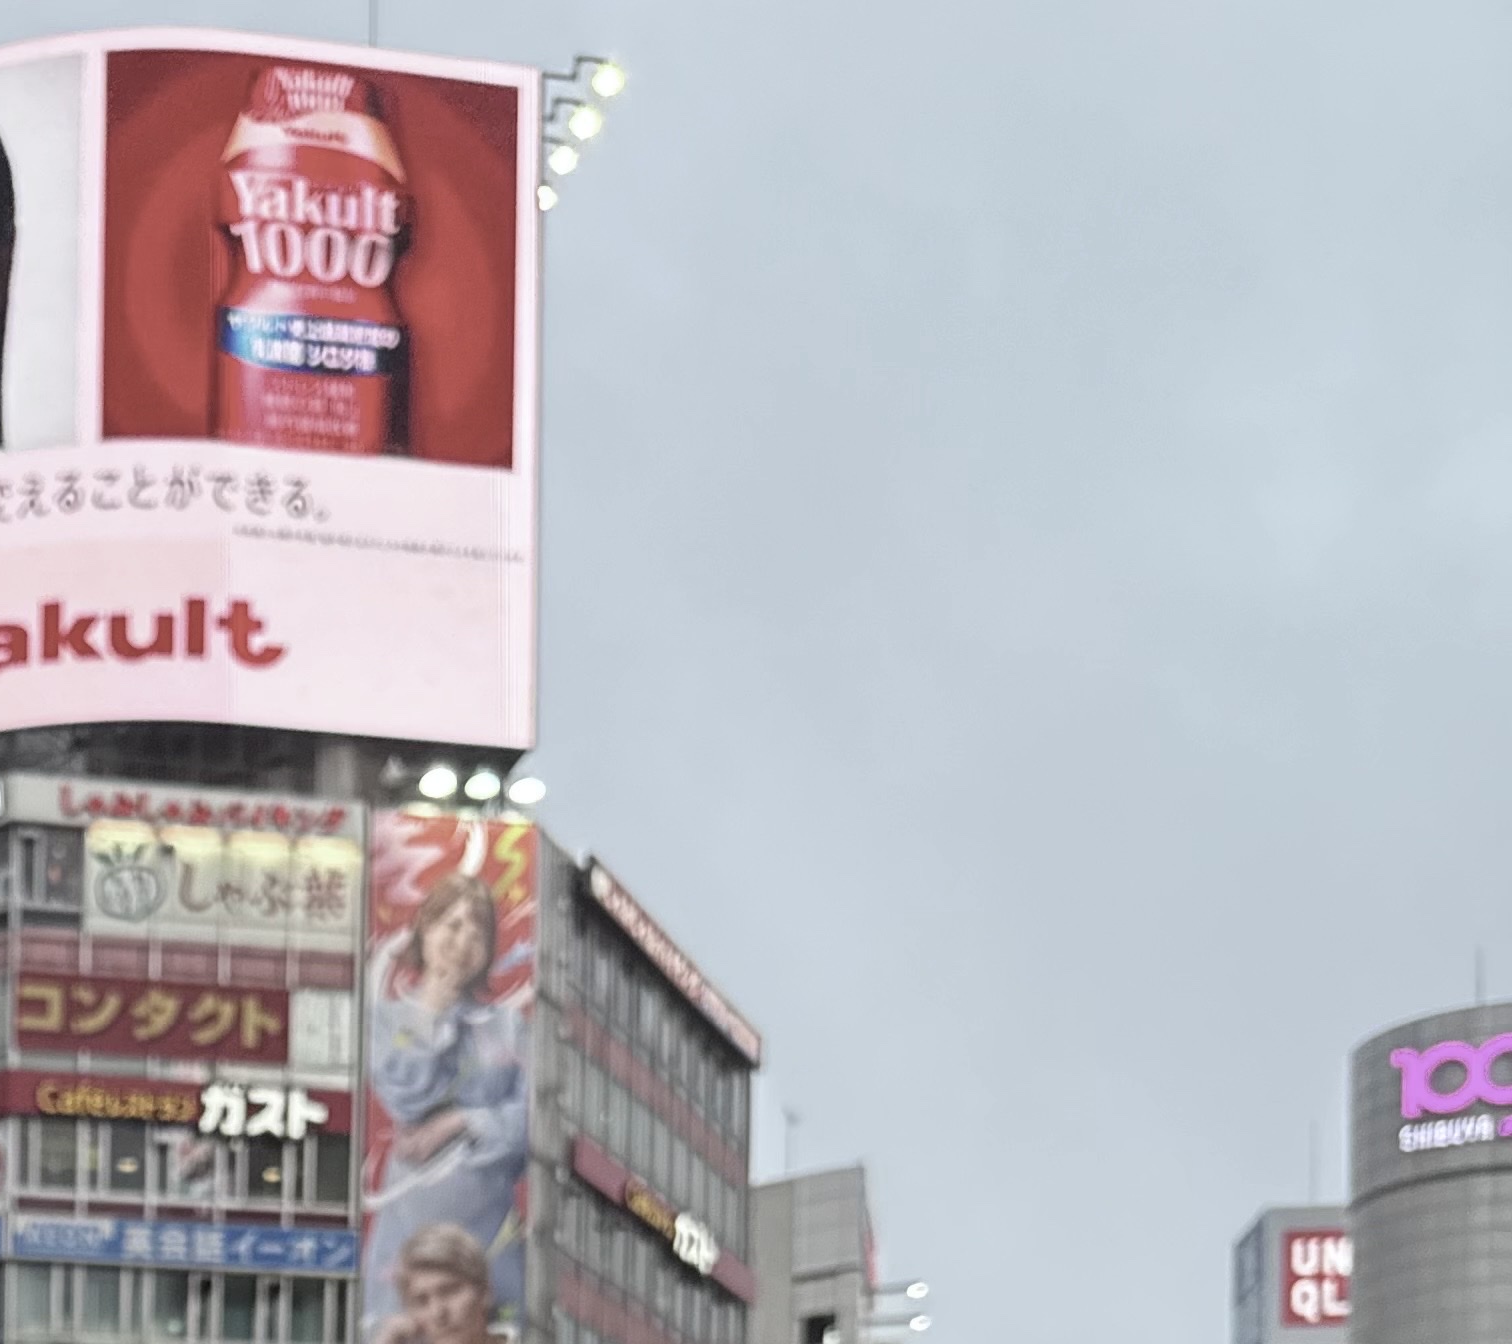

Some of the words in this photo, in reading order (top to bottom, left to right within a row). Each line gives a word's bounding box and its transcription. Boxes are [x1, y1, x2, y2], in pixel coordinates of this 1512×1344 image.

[229, 170, 400, 234] Yakult
[230, 220, 393, 288] 1000
[16, 983, 280, 1049] コンタクト
[199, 1083, 329, 1140] ガスト
[1398, 1113, 1495, 1153] SHIBUYA
[122, 1222, 356, 1269] 英会話イーオン
